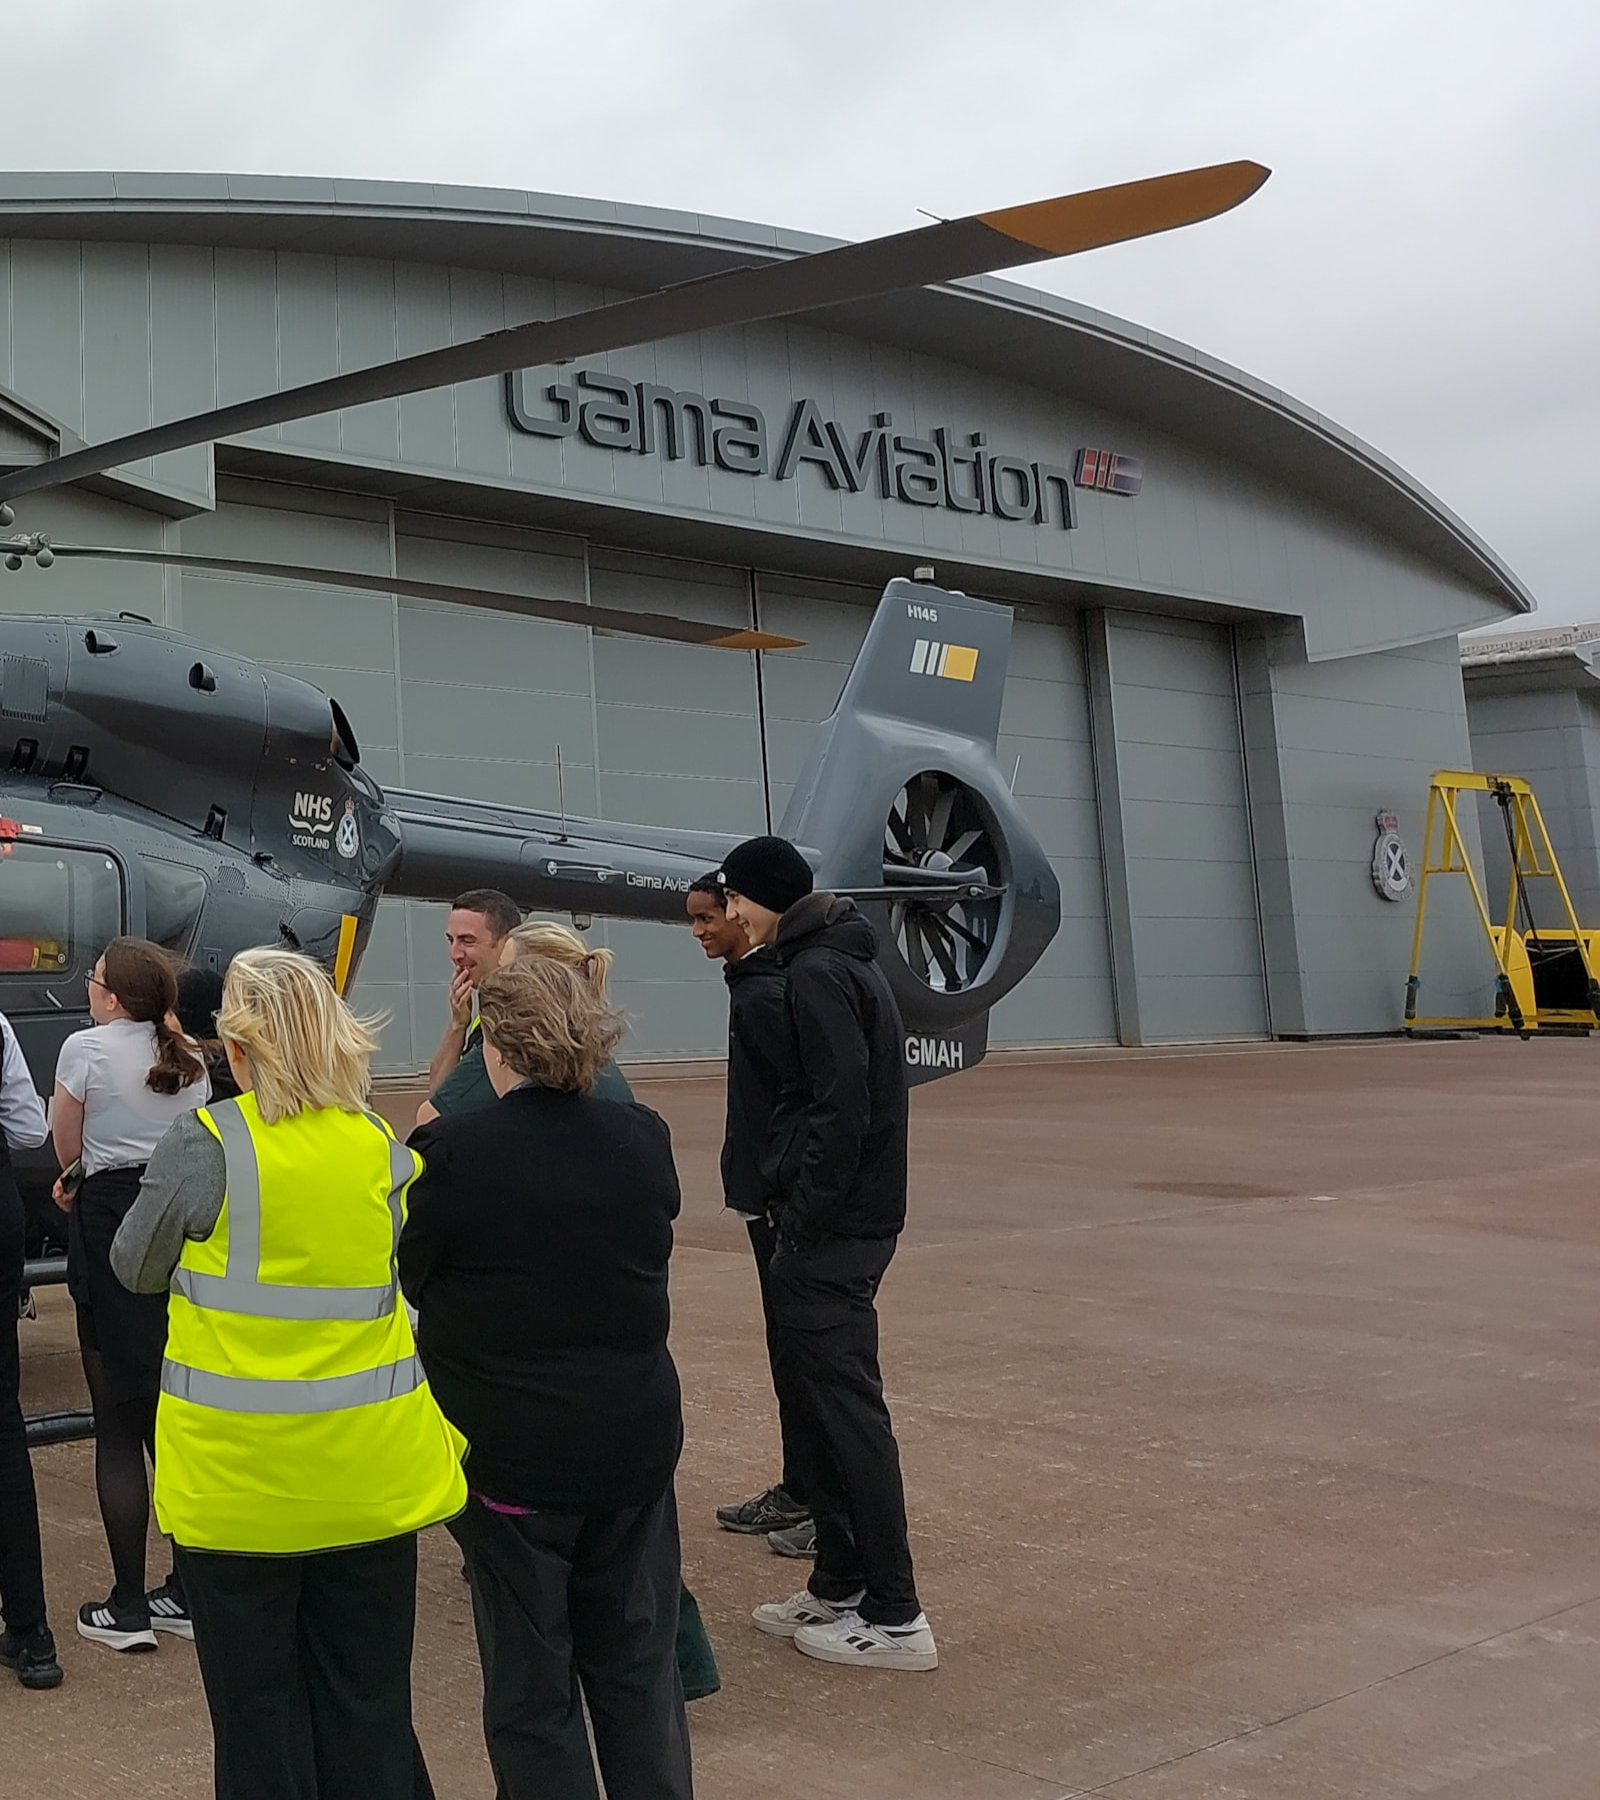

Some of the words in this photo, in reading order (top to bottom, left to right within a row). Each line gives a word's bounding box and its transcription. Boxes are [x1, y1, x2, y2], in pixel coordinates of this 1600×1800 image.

[504, 369, 769, 475] Gama
[776, 399, 1079, 530] Aviation
[907, 604, 938, 623] H145
[294, 791, 333, 821] NHS
[292, 834, 330, 850] SCOTLAND
[626, 871, 662, 889] Gama
[904, 1036, 964, 1070] GMAH
